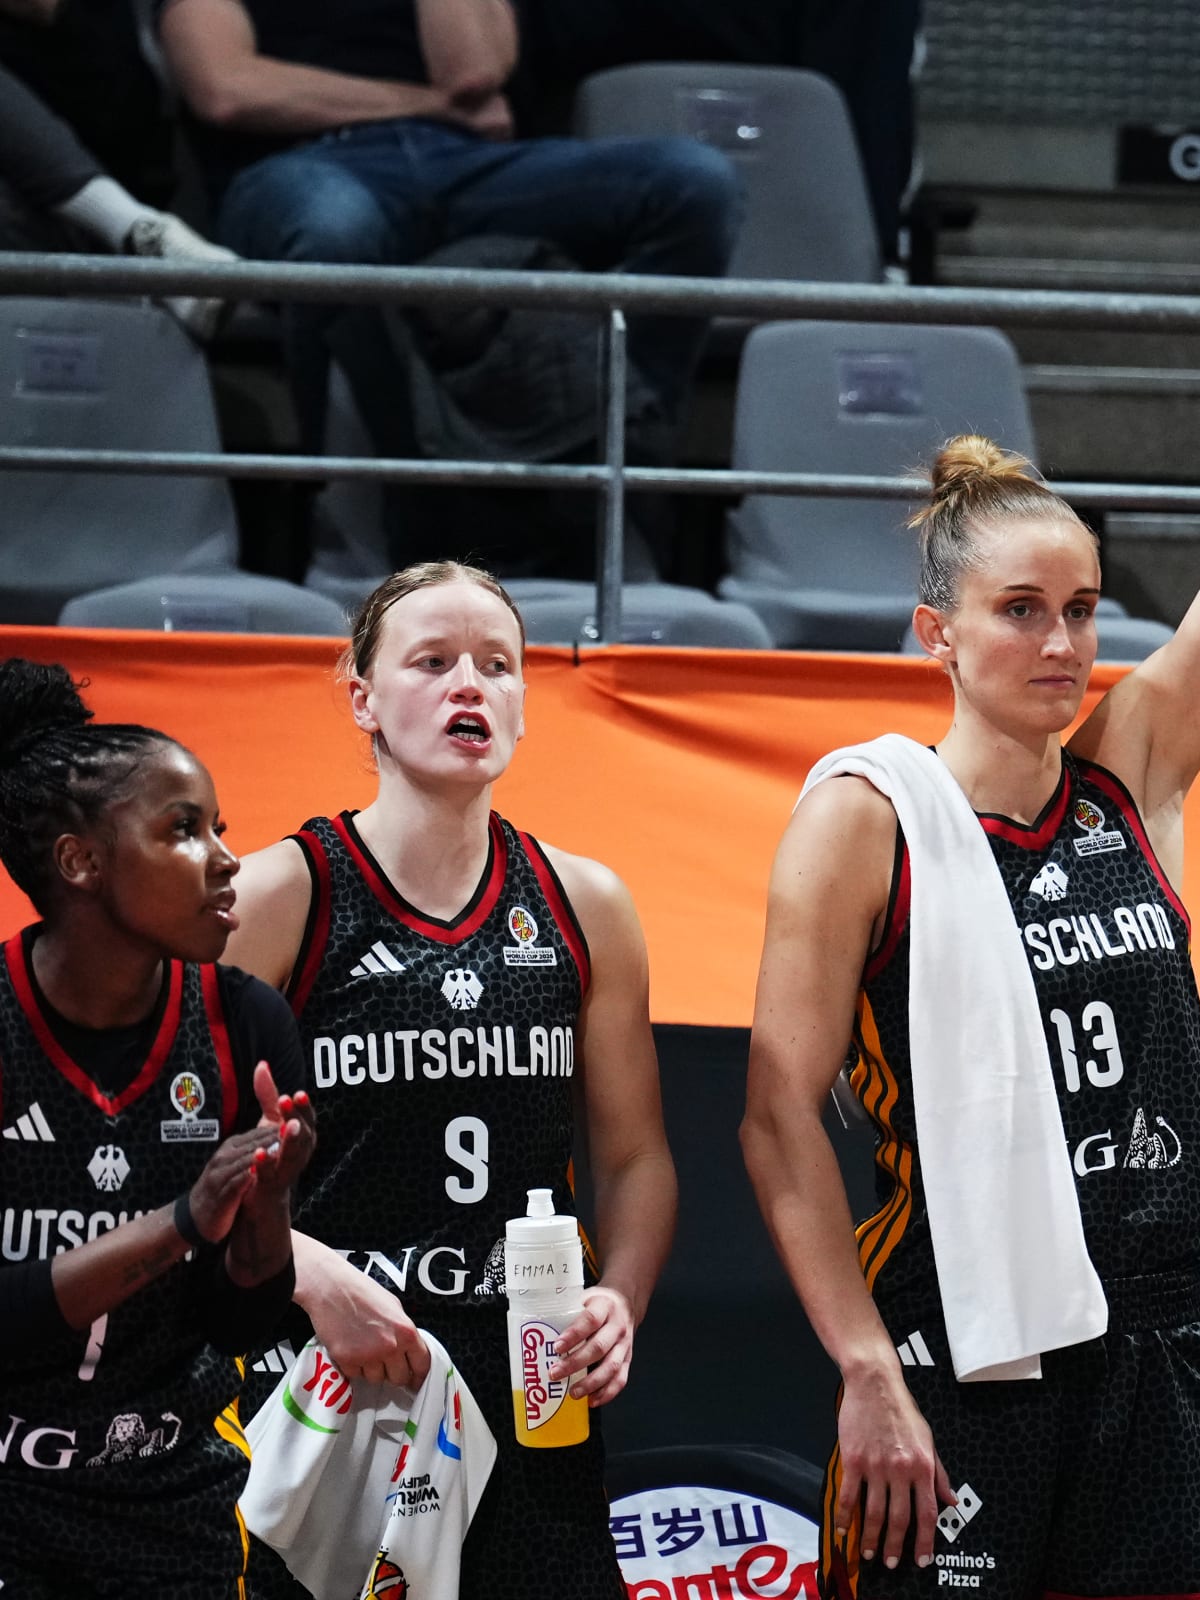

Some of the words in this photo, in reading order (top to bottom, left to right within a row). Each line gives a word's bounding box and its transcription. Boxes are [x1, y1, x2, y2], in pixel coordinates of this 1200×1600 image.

[1018, 903, 1175, 971] SCHLAND
[314, 1026, 574, 1088] DEUTSCHLAND
[1050, 1000, 1124, 1093] 13
[445, 1116, 489, 1204] 9
[514, 1264, 554, 1277] EMMA
[562, 1263, 569, 1274] 2
[609, 1503, 768, 1560] 百岁山
[935, 1550, 996, 1569] omino's
[938, 1569, 980, 1588] Pizza
